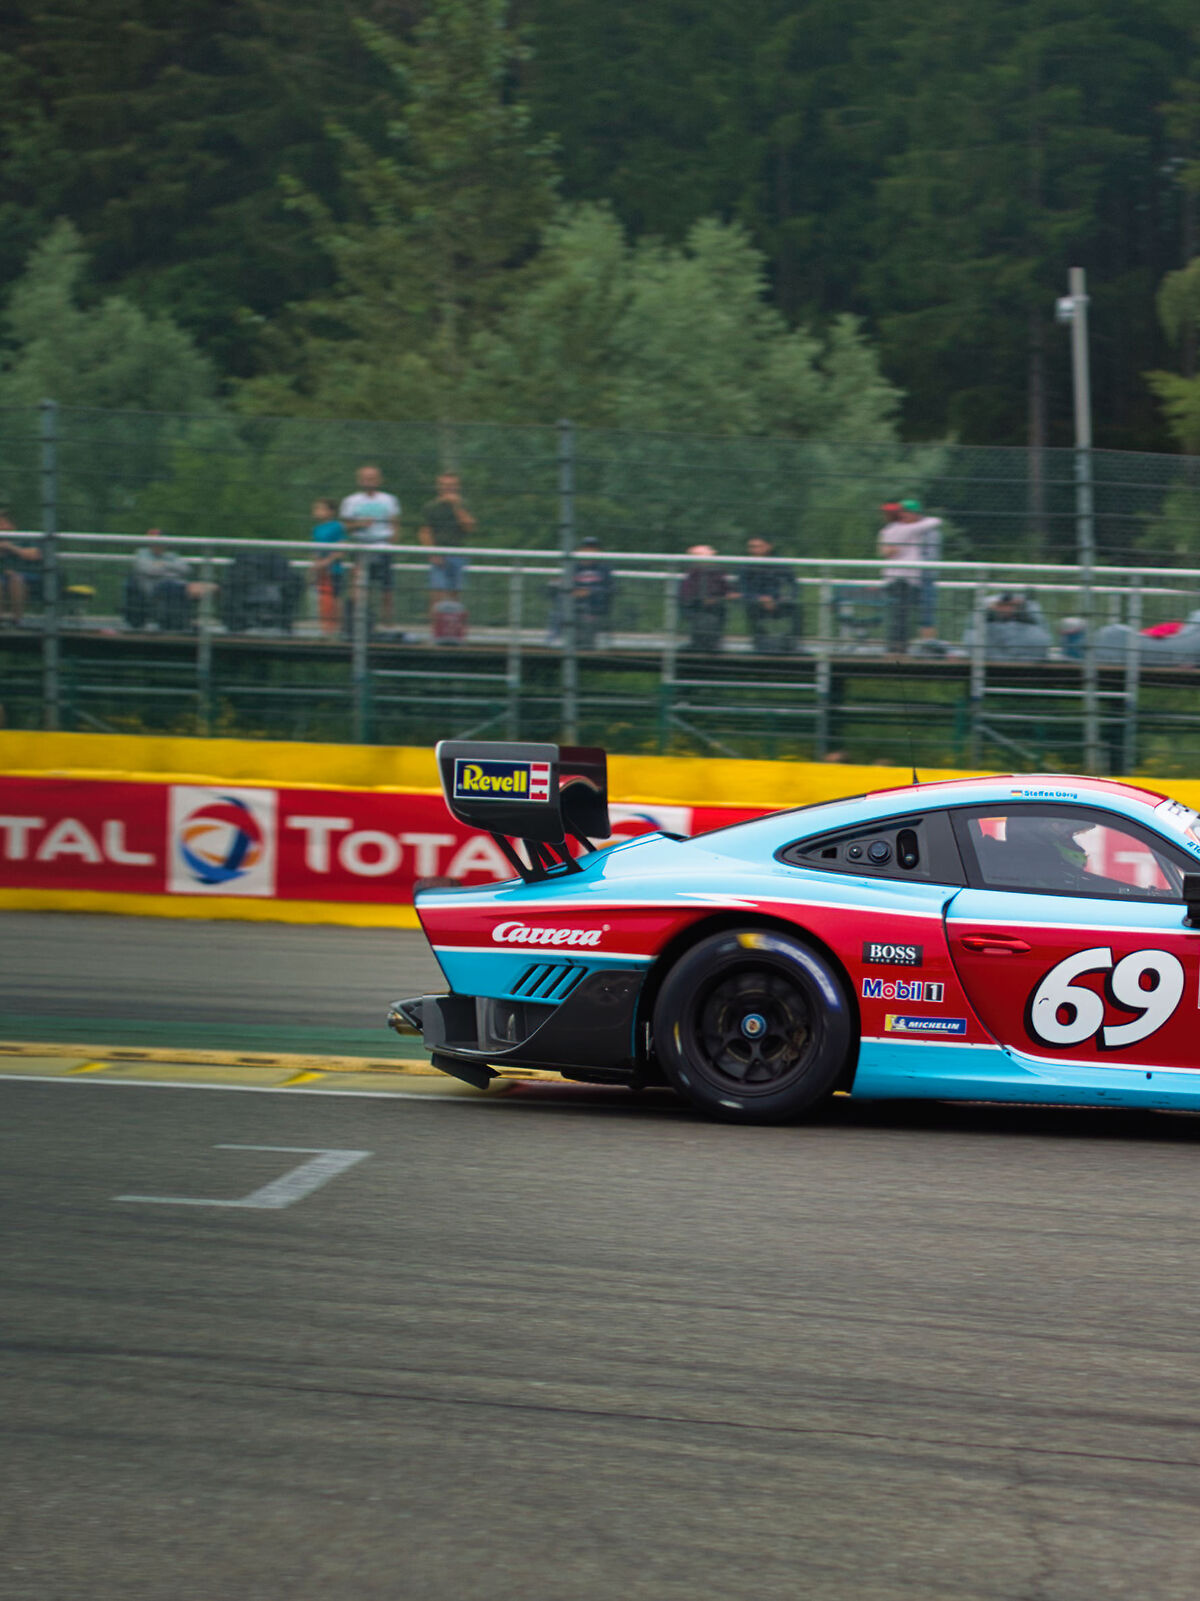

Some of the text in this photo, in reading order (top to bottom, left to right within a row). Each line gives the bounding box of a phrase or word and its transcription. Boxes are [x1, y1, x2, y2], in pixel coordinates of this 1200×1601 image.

[463, 764, 528, 793] Revell
[286, 815, 533, 878] TOTA
[492, 921, 603, 946] Carrera
[870, 944, 916, 960] BOSS
[862, 978, 922, 1001] Mobil
[1025, 946, 1186, 1050] 69
[908, 1020, 960, 1030] MICHELIN
